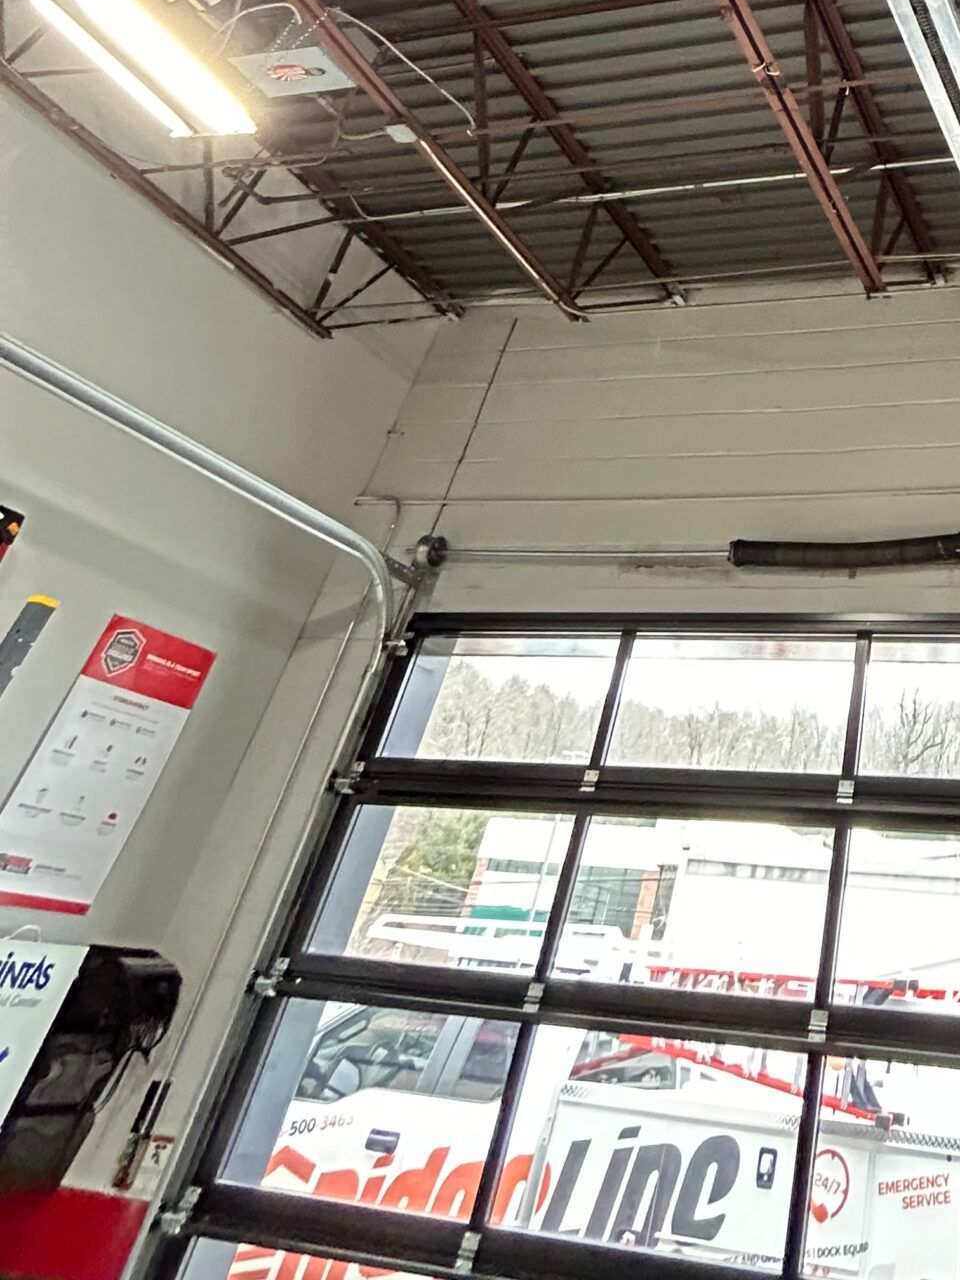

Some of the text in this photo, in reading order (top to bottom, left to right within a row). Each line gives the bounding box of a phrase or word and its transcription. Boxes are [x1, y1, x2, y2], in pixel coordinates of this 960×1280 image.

[814, 1172, 841, 1196] 24/7
[877, 1173, 950, 1196] EMERGENCY
[901, 1190, 951, 1210] SERVICE
[816, 1244, 842, 1260] DOCK
